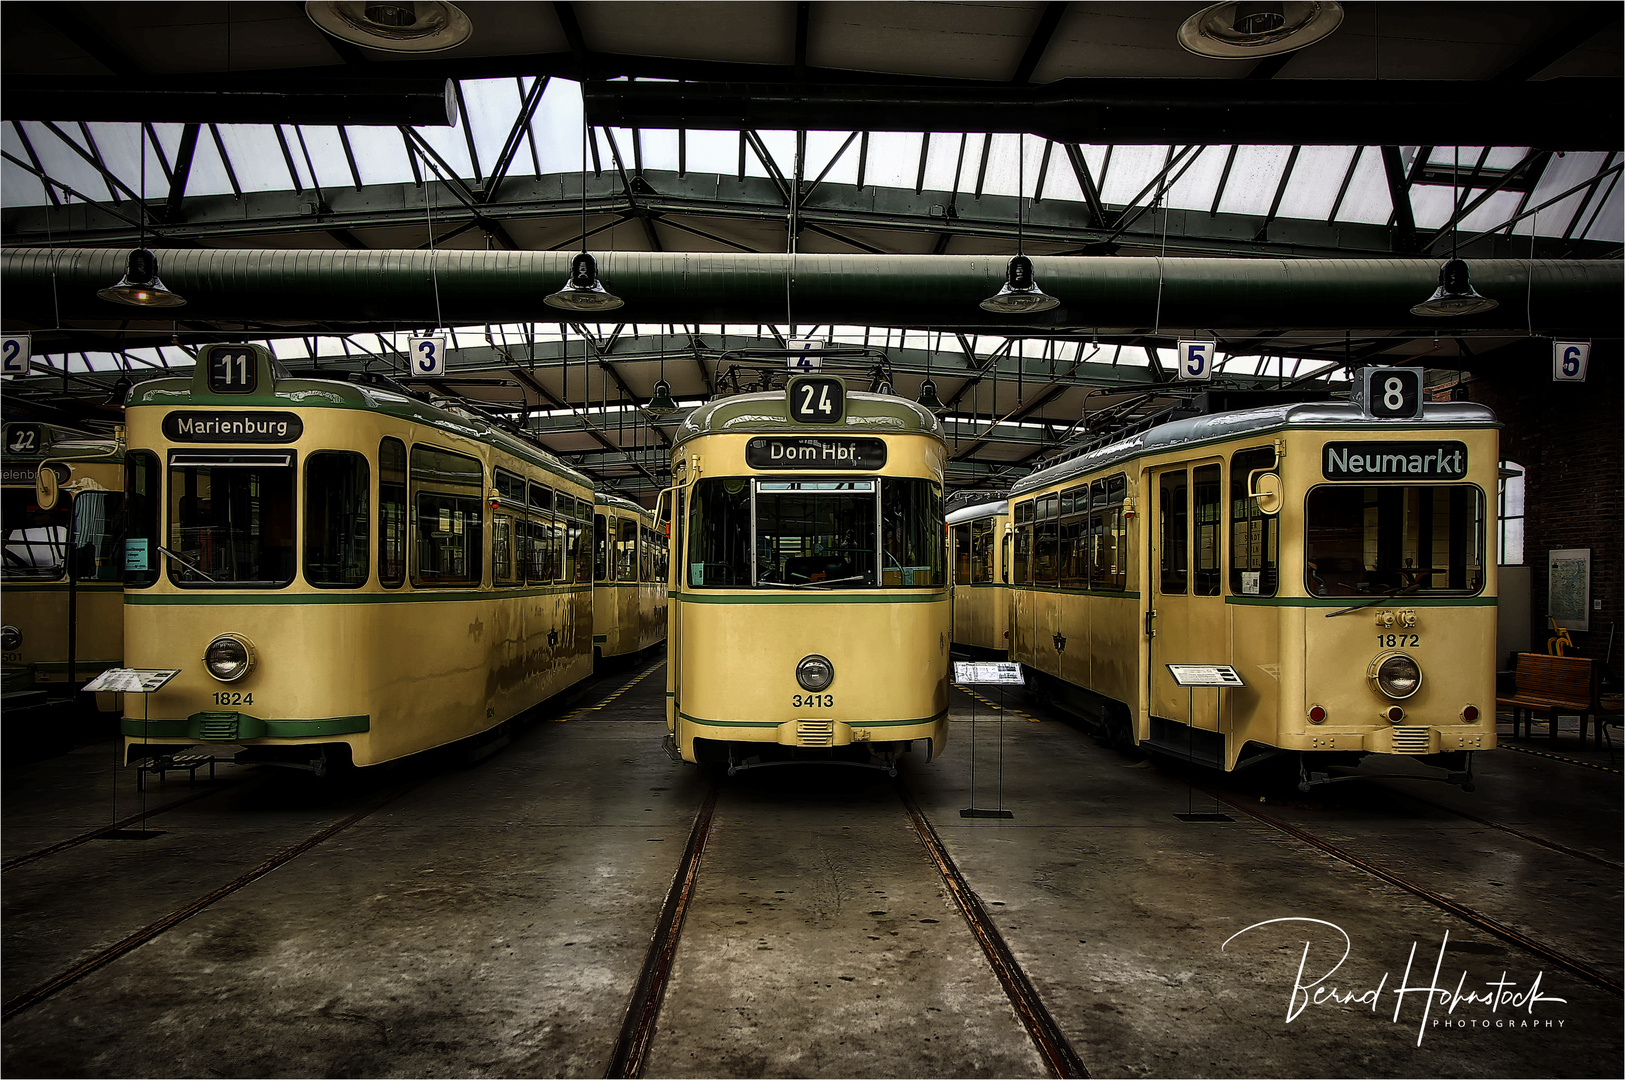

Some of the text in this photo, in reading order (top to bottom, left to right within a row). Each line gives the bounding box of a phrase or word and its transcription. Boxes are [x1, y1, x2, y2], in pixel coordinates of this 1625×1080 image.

[3, 340, 21, 371] 2
[221, 354, 247, 385] 11
[418, 341, 436, 373] 3
[797, 343, 813, 374] 4
[1187, 344, 1206, 376] 5
[1562, 346, 1581, 378] 6
[800, 384, 832, 415] 24
[1383, 377, 1404, 410] 8
[16, 430, 35, 449] 22
[178, 417, 288, 438] Marienburg
[770, 442, 862, 460] Dom Hbf.
[1327, 447, 1463, 474] Neumarkt
[1376, 633, 1420, 648] 1872
[212, 691, 254, 706] 1824
[791, 694, 835, 708] 3413
